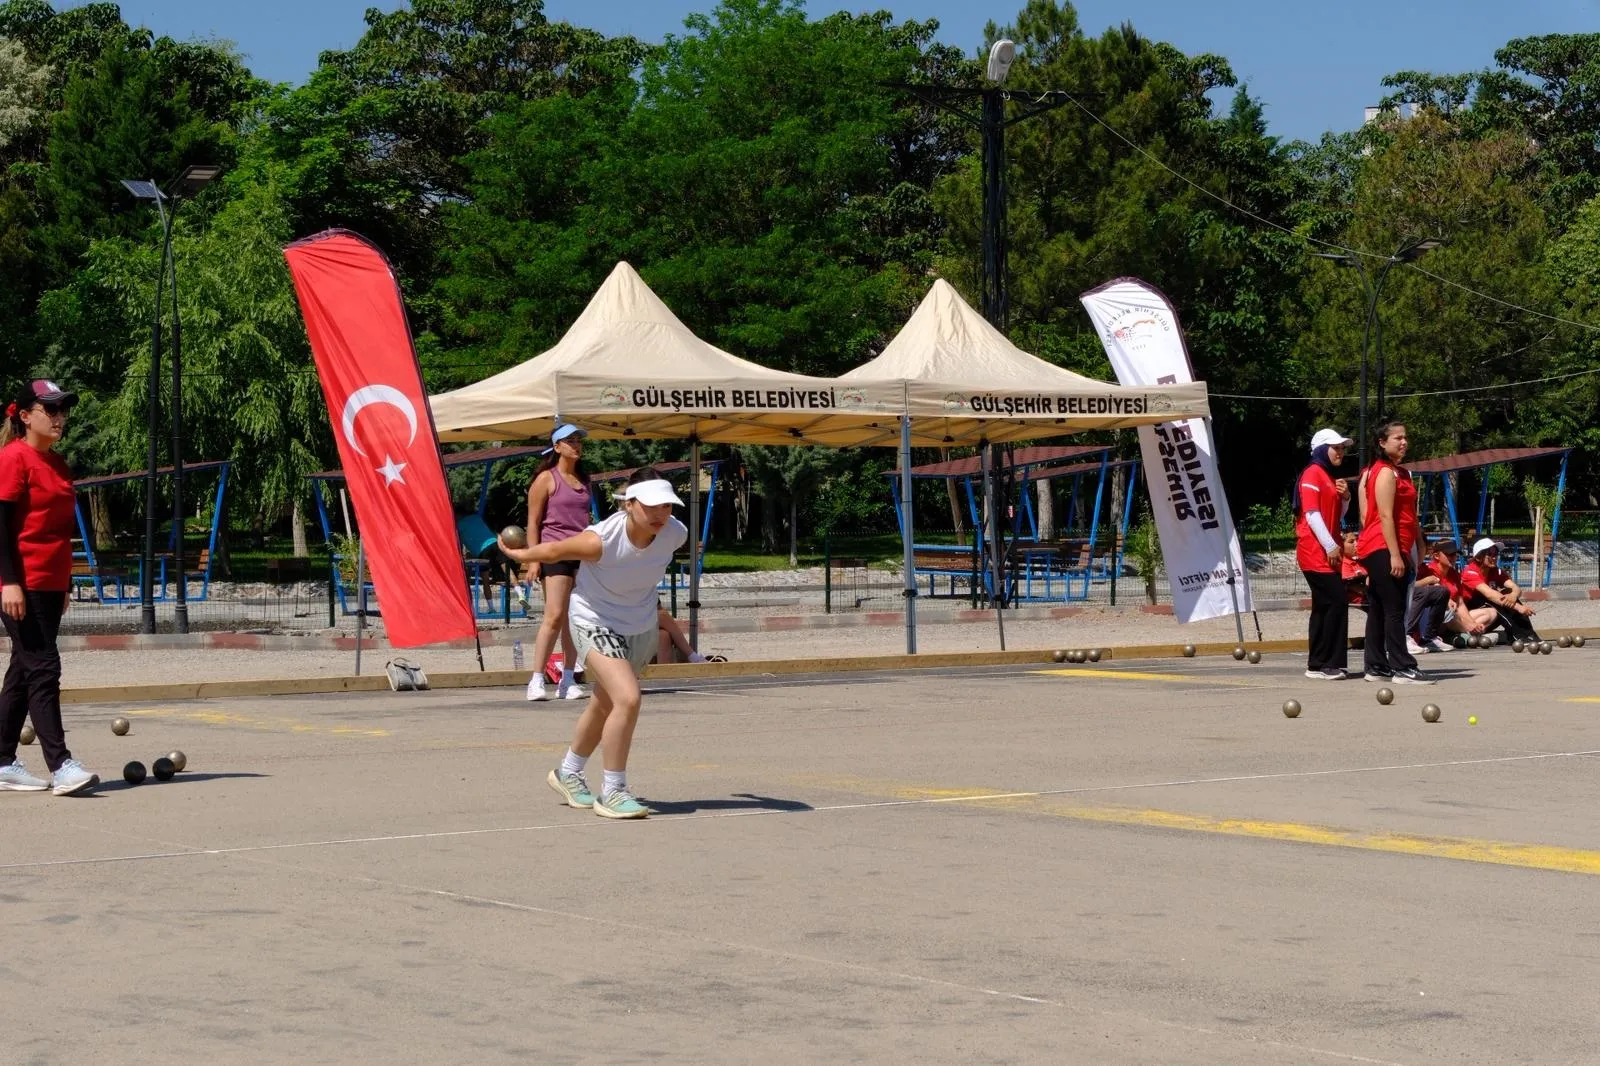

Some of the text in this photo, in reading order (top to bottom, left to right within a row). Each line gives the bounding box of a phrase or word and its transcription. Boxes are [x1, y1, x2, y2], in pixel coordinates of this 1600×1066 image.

[632, 386, 727, 412] GÜLŞEHİR
[733, 387, 836, 409] BELEDİYESİ
[971, 393, 1053, 416] GÜLŞEHİR
[1057, 394, 1148, 414] BELEDİYESİ
